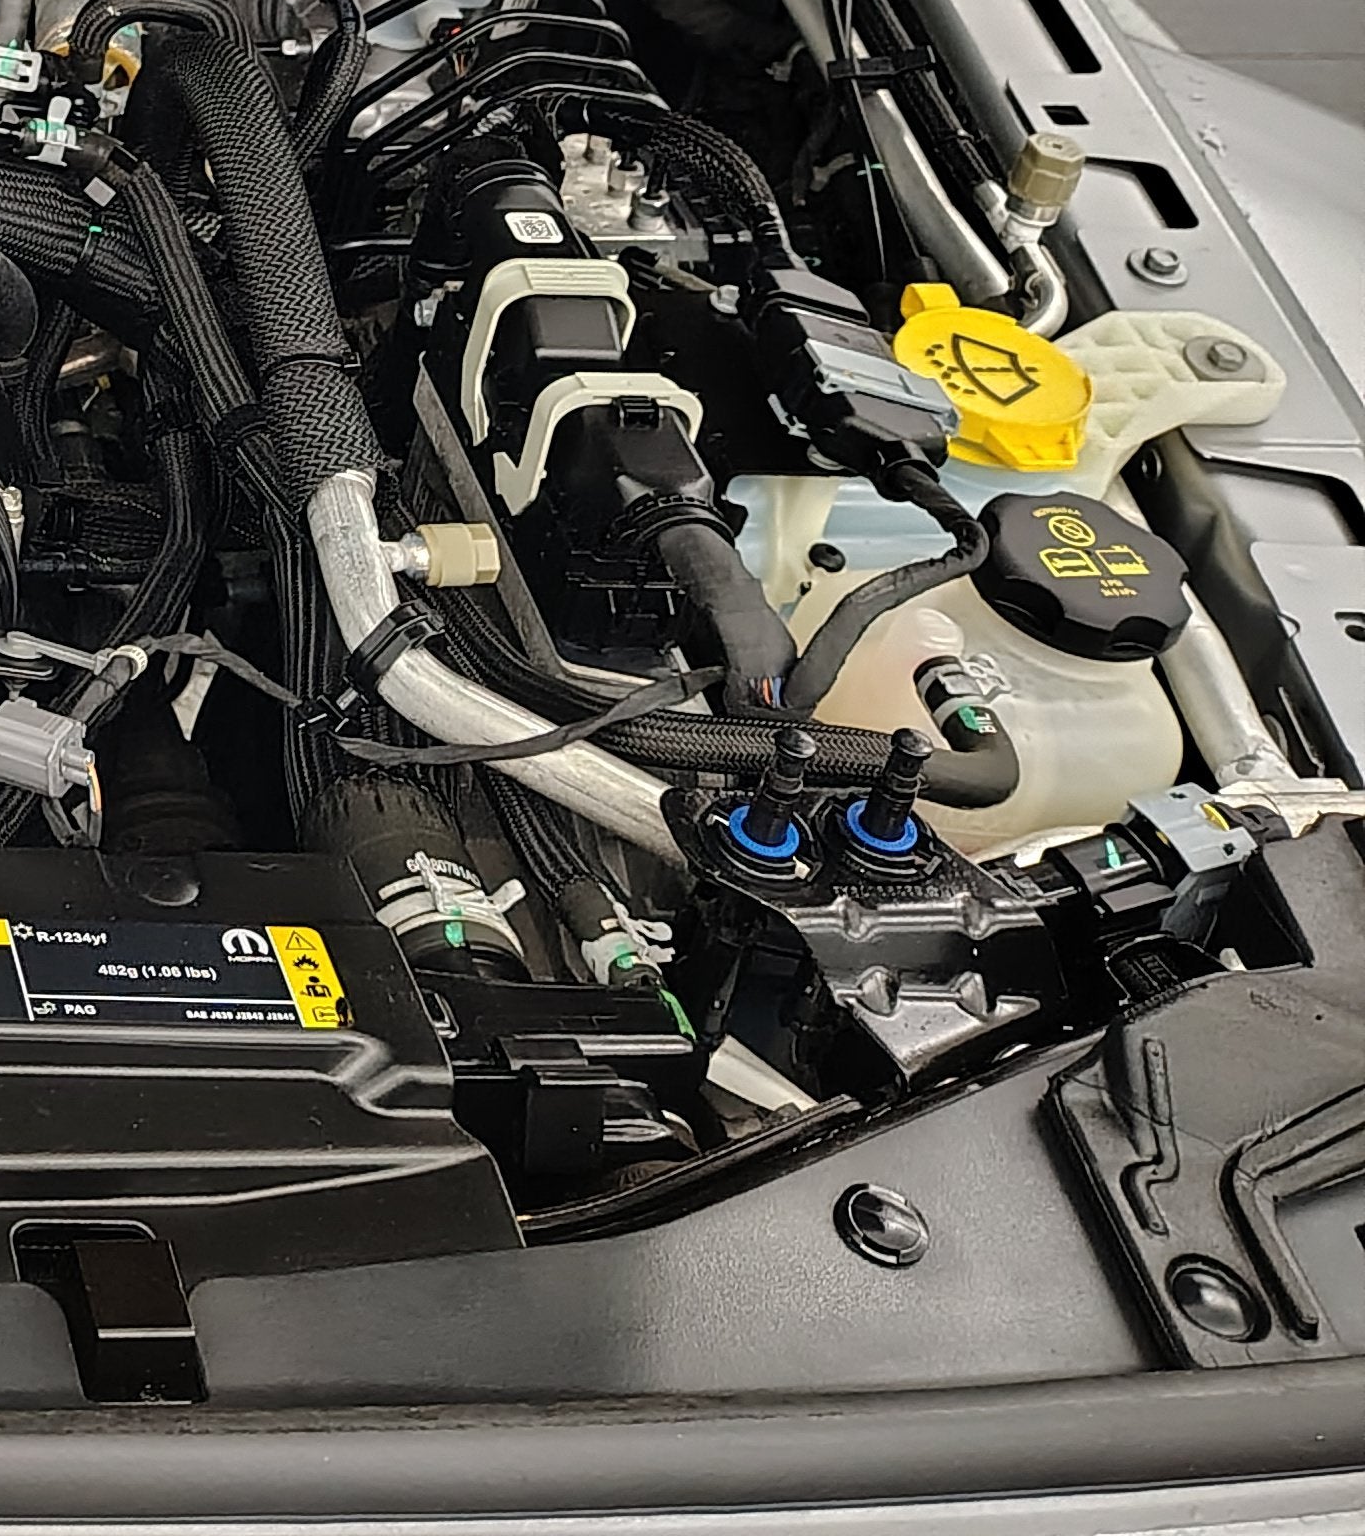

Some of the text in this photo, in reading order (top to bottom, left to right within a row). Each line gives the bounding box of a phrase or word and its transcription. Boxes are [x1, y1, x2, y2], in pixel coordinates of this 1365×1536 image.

[36, 931, 108, 946] R-1234yf
[97, 963, 218, 982] 482g (1.06 lbs)
[63, 1005, 97, 1016] PAG
